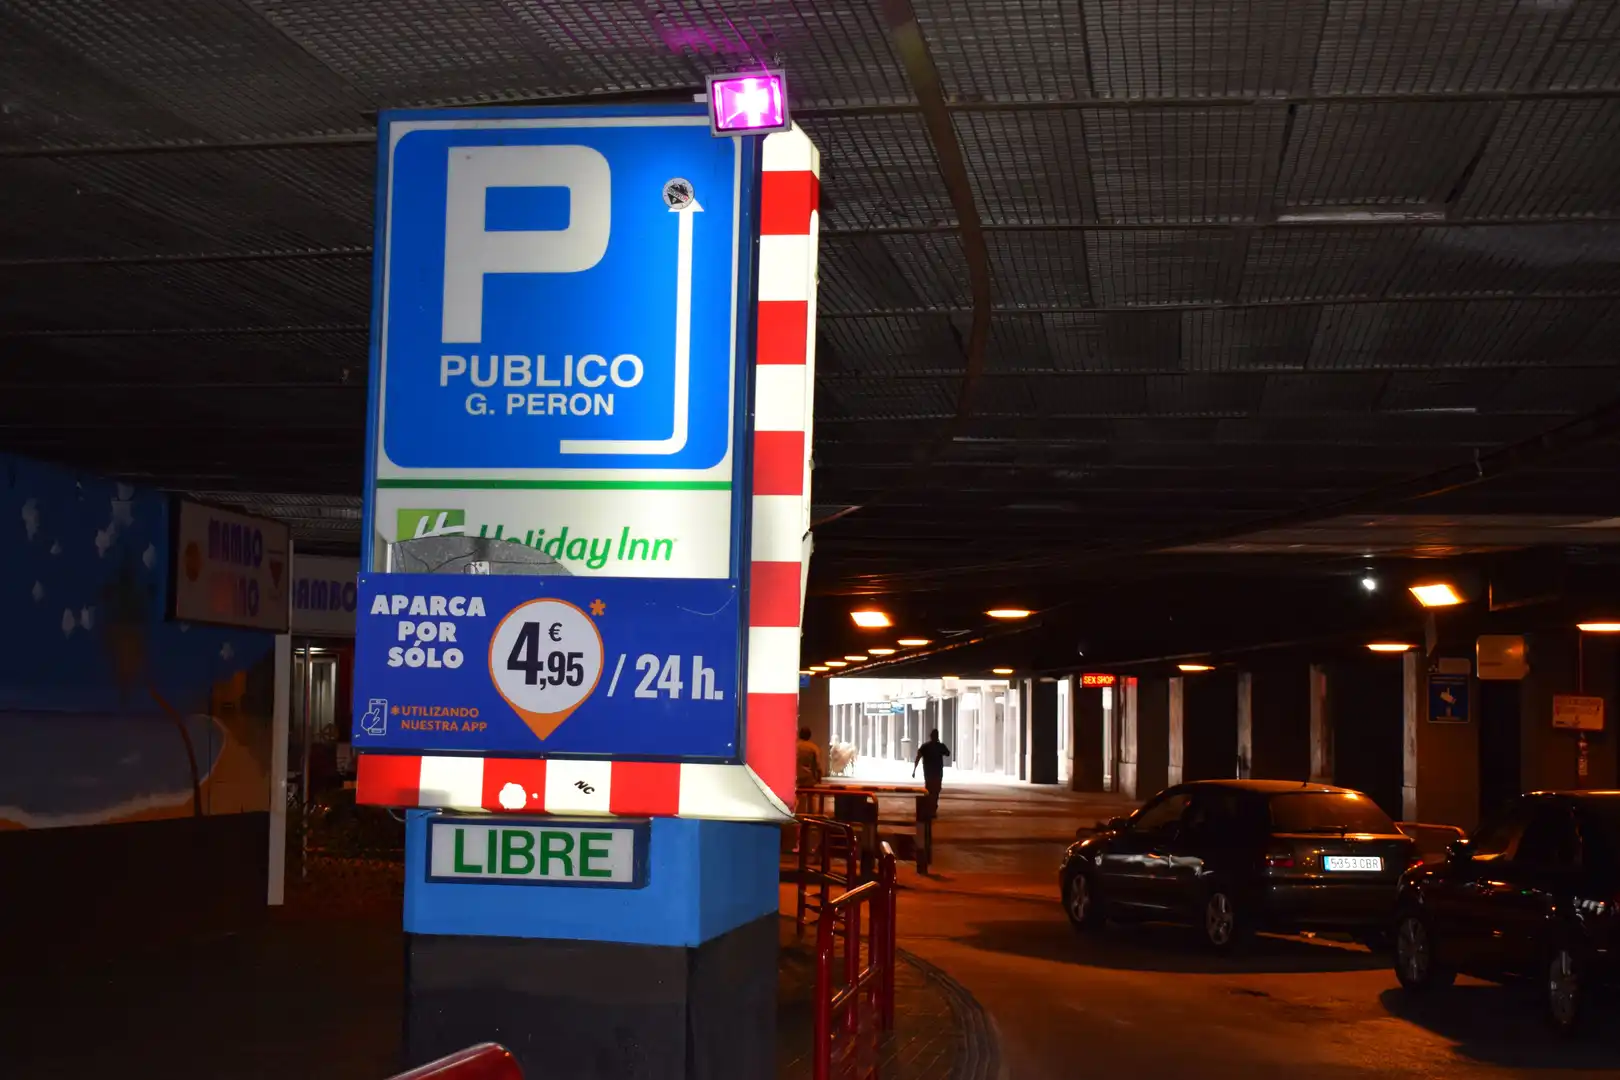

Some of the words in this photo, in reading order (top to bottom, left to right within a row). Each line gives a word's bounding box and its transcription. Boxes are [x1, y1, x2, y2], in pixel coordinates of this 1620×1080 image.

[441, 144, 611, 343] P
[439, 353, 644, 388] PUBLICO
[465, 392, 495, 415] G.
[506, 393, 614, 416] PERON
[208, 516, 263, 568] MAMBO
[479, 524, 612, 569] liday
[617, 526, 674, 561] Inn
[293, 578, 357, 612] AMBO
[370, 594, 486, 617] APARCA
[398, 620, 457, 642] POR
[387, 640, 464, 669] SÓLO
[634, 653, 684, 699] 24
[1083, 675, 1096, 685] SEX
[1096, 675, 1114, 685] SHOP
[401, 719, 458, 731] NUESTRA
[461, 721, 488, 732] APP
[454, 828, 613, 877] LIBRE
